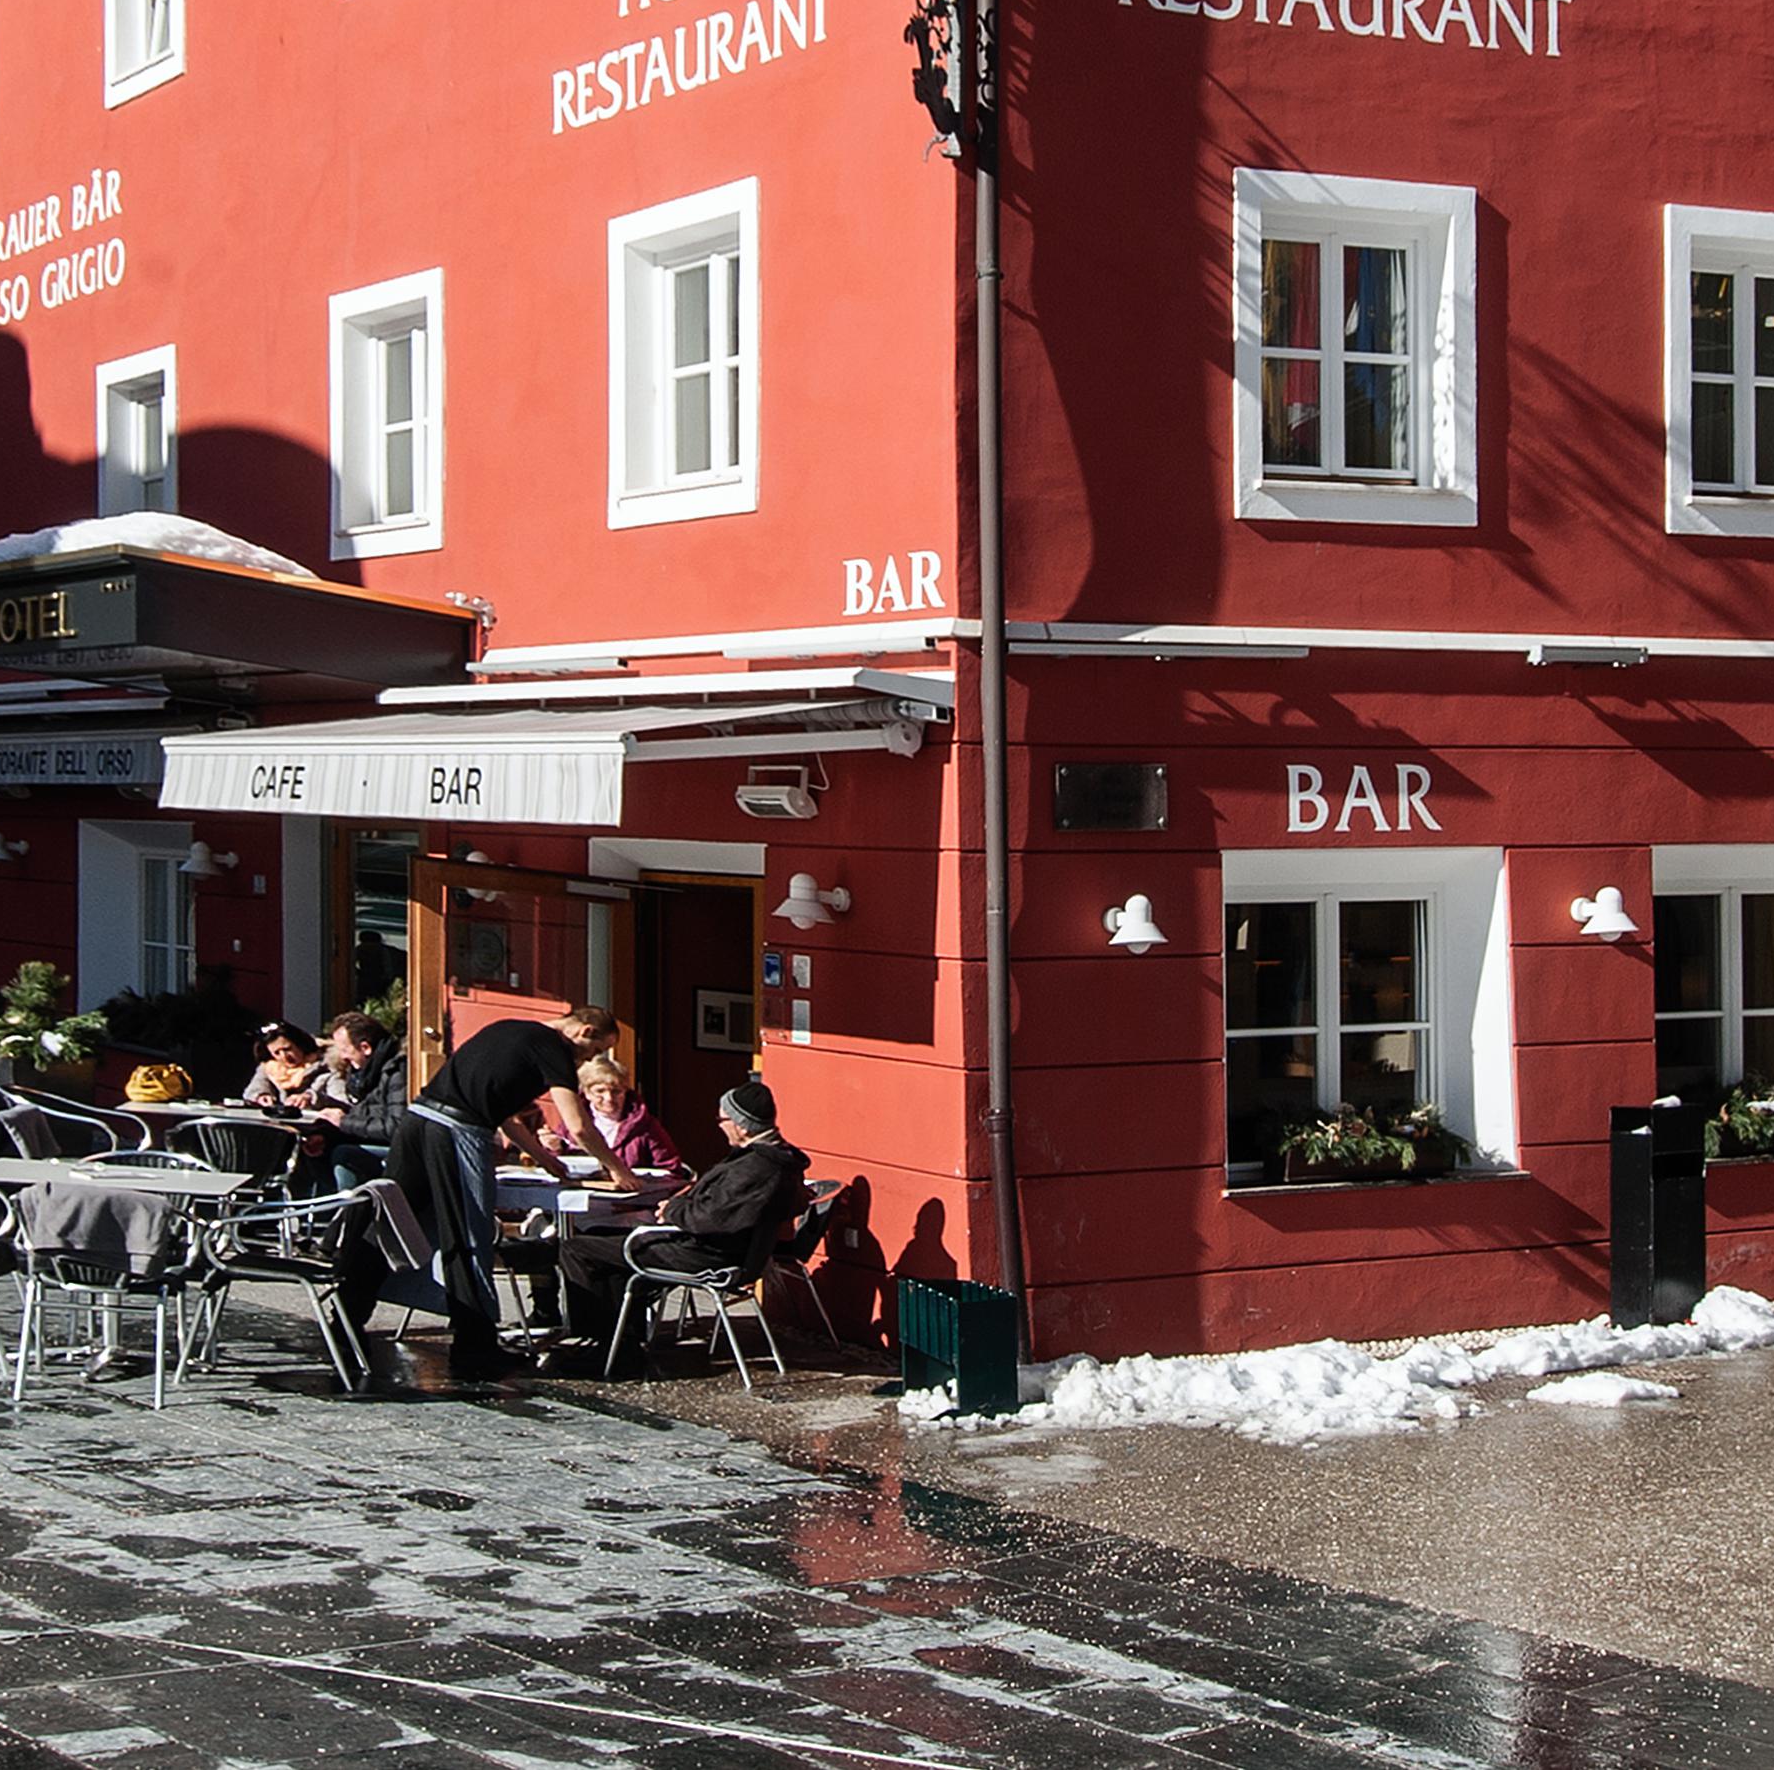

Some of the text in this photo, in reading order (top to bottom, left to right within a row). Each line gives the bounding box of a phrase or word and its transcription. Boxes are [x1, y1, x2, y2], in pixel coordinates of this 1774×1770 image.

[71, 168, 122, 231] BÄR
[41, 237, 126, 309] GRIGIO
[842, 549, 946, 616] BAR
[96, 749, 133, 775] ORSO
[251, 765, 305, 800] CAFE
[430, 767, 482, 805] BAR
[1286, 763, 1443, 832] BAR
